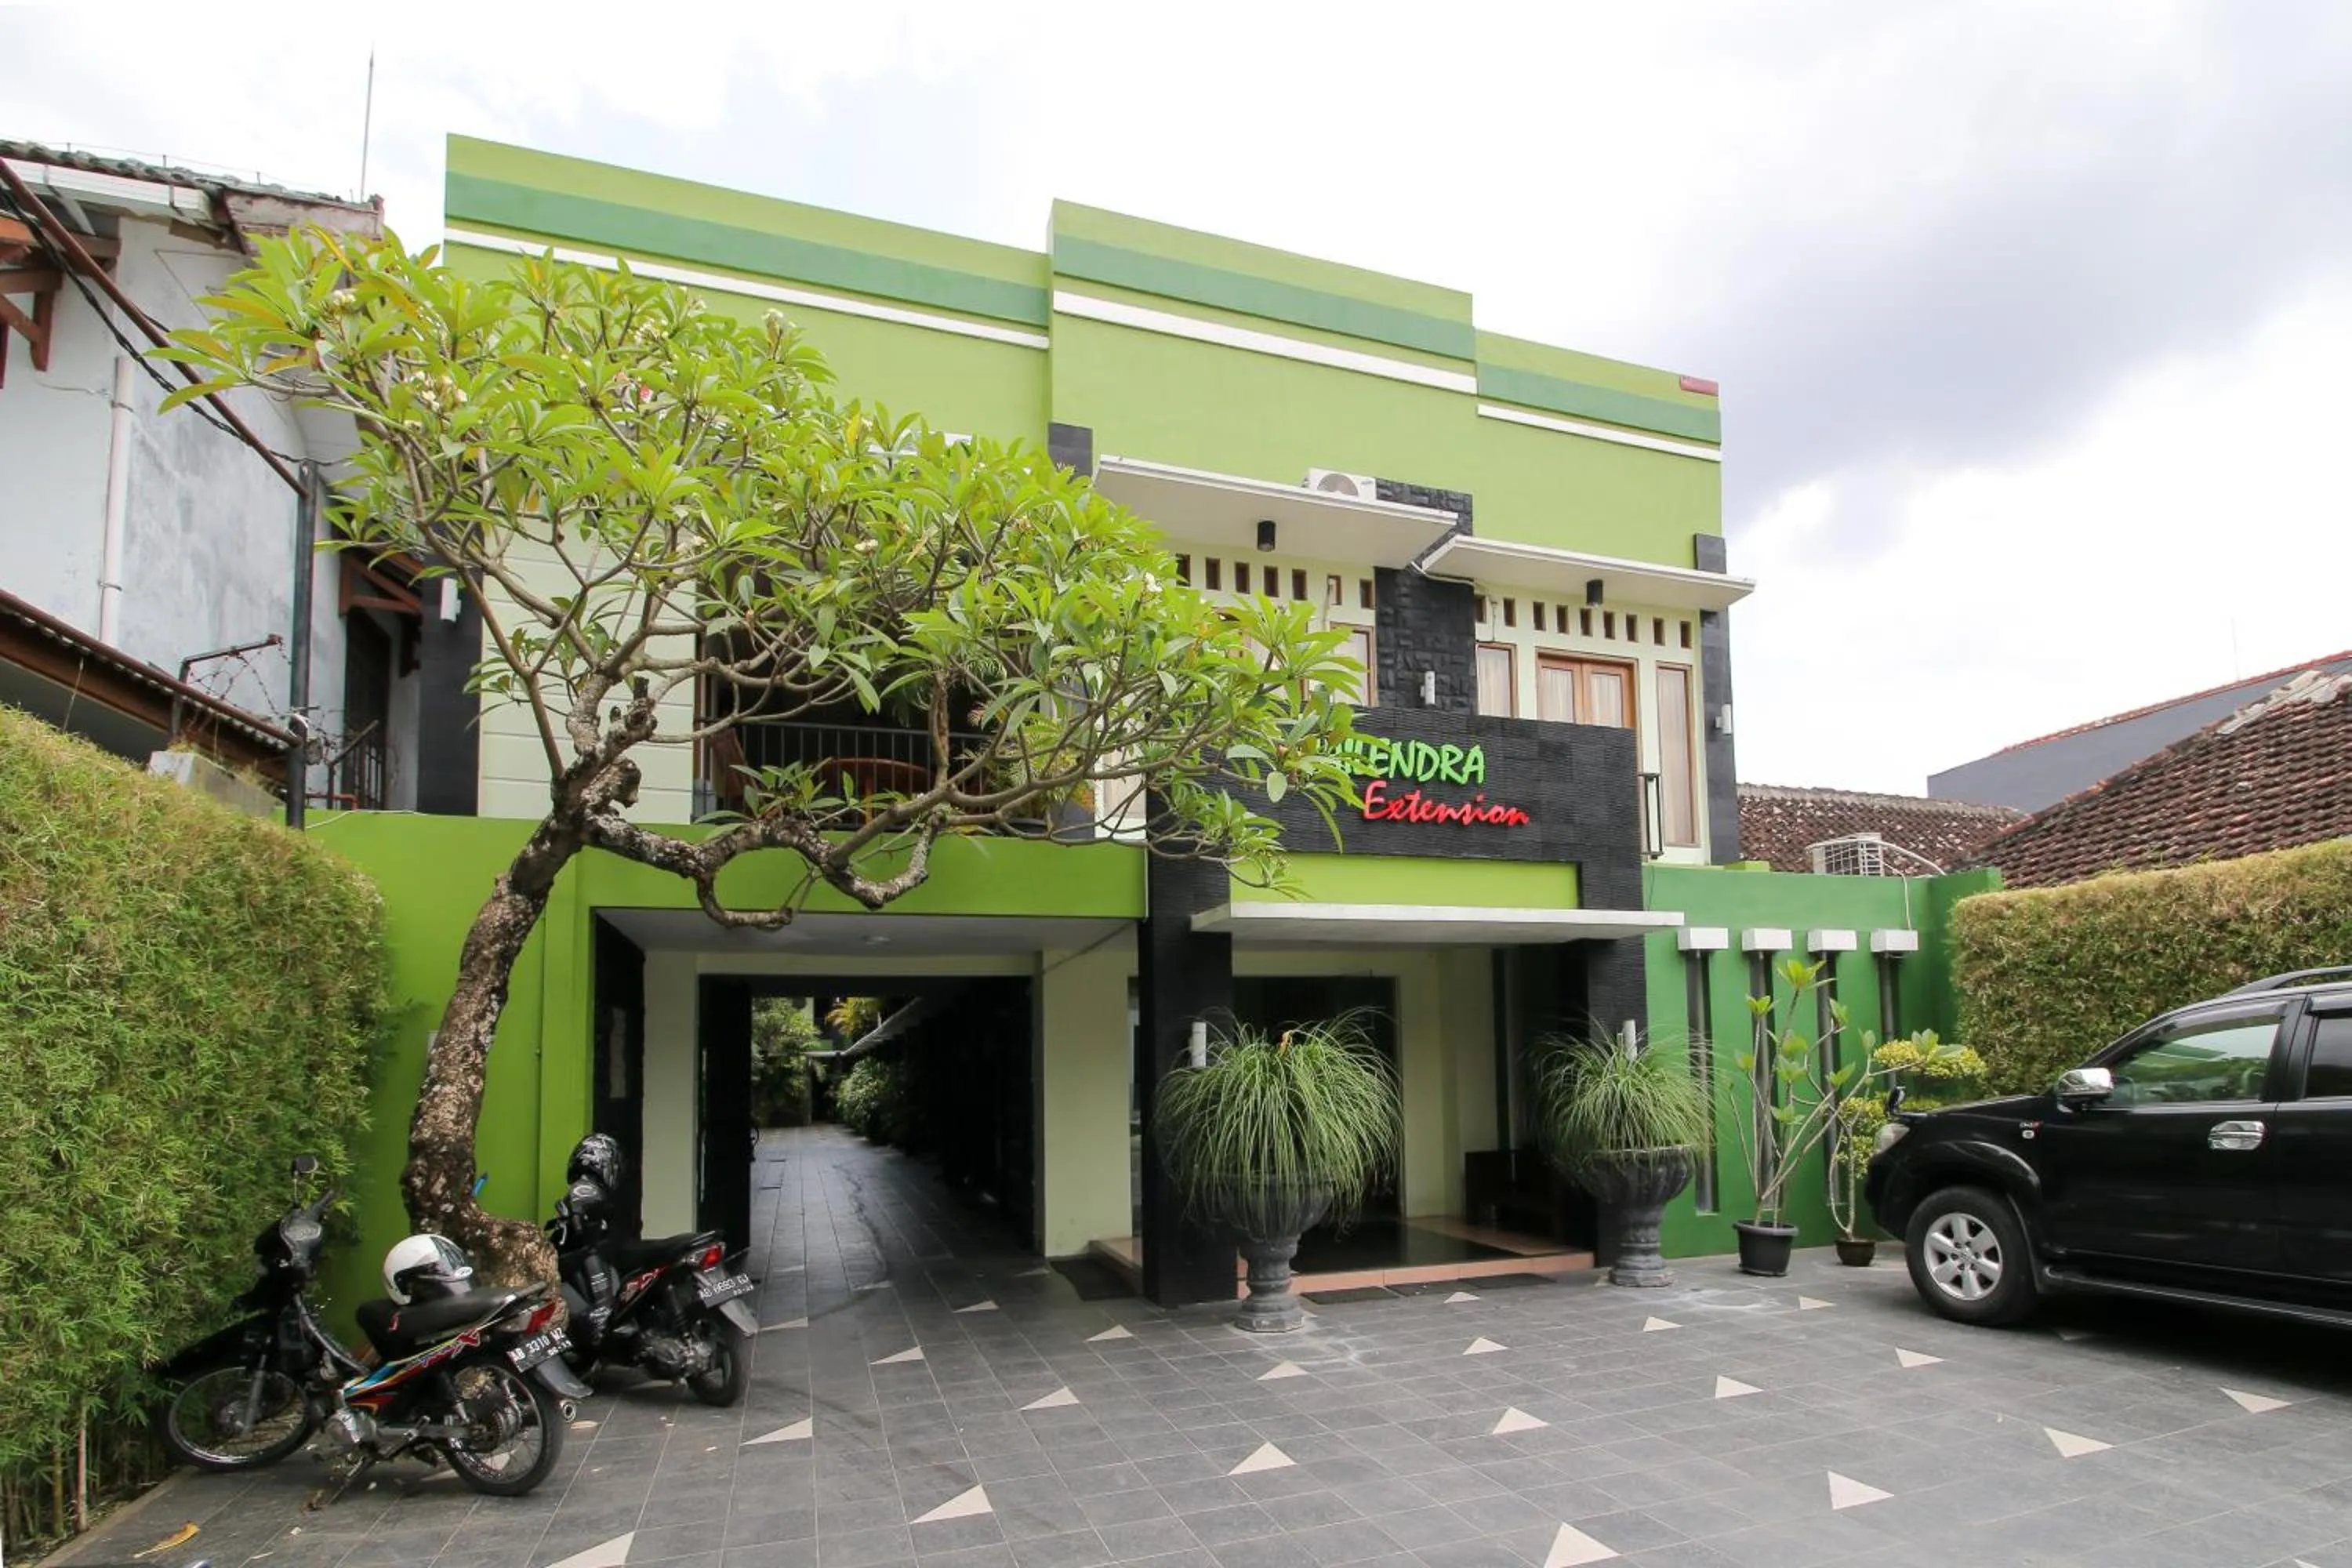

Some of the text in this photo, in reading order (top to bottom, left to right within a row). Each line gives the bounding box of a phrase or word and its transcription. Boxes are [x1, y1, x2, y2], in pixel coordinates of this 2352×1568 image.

[1363, 780, 1531, 826] Extension
[506, 1348, 526, 1362] AB
[525, 1334, 551, 1354] 3310
